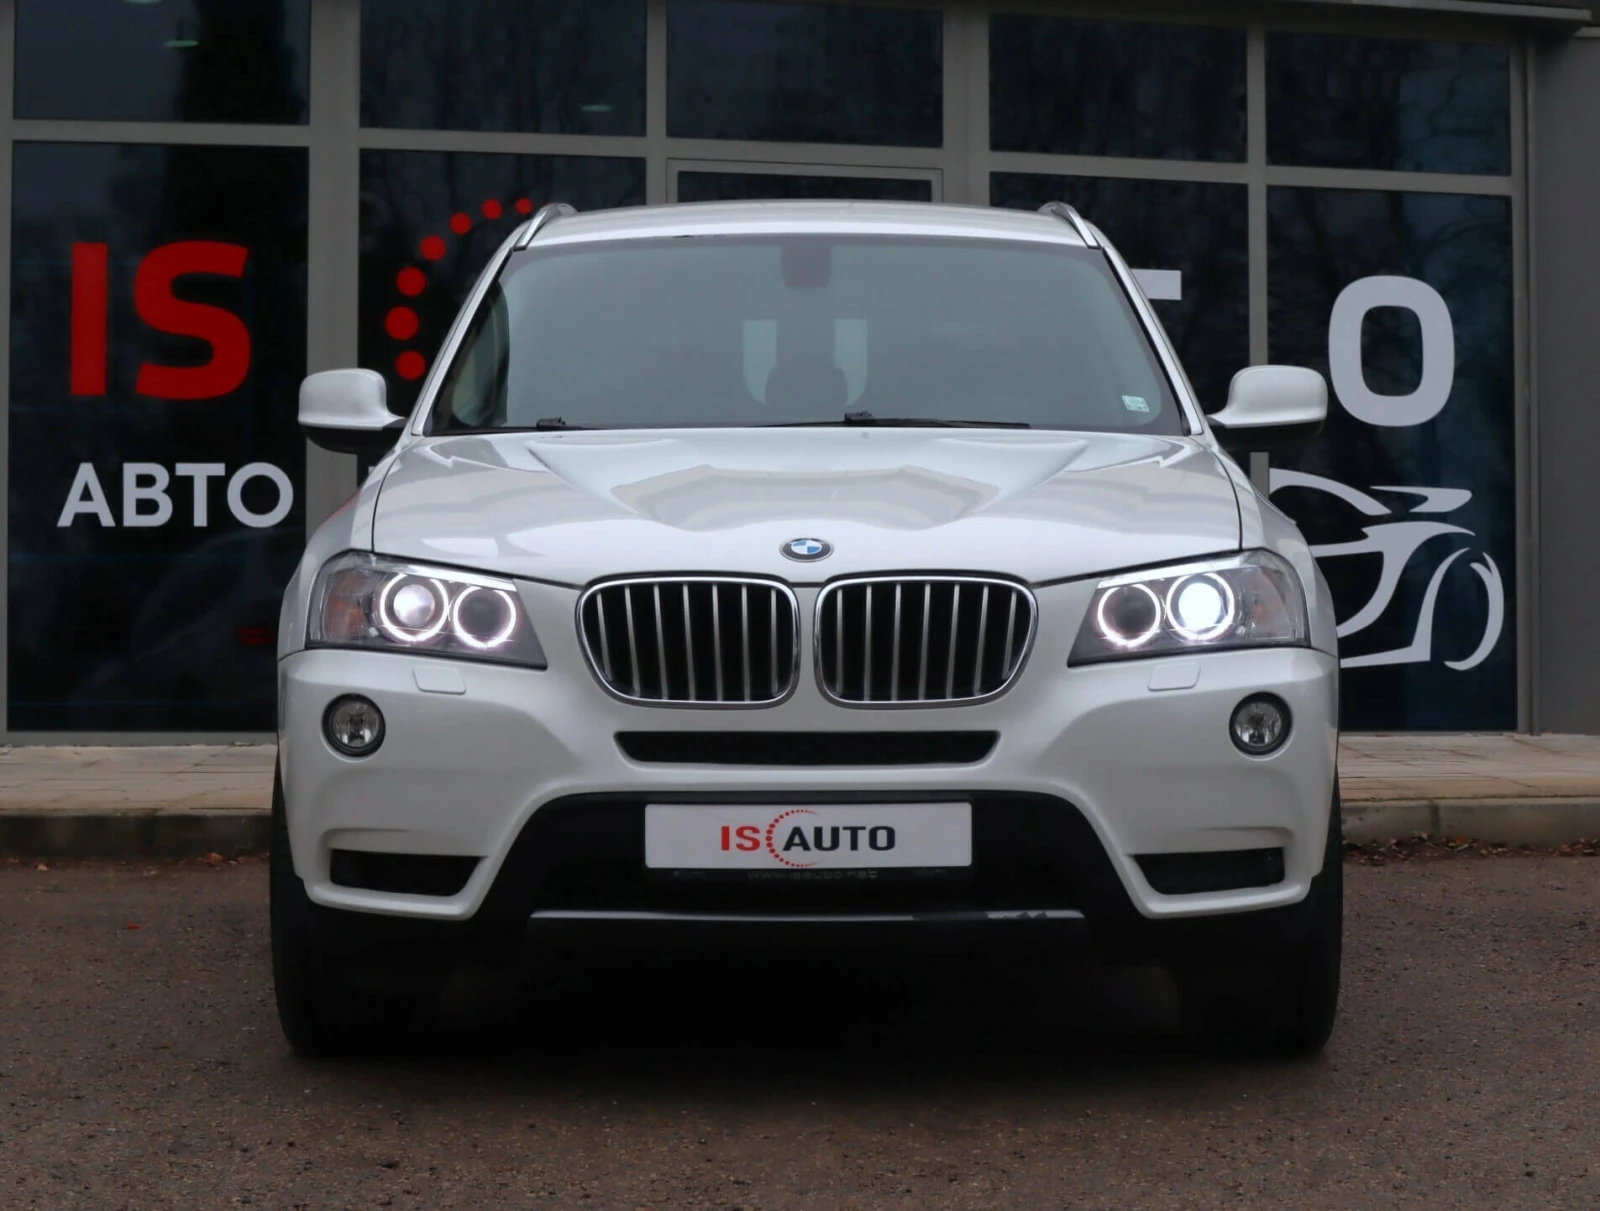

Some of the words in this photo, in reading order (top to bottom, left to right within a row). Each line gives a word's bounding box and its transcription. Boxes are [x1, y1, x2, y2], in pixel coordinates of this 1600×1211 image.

[71, 240, 252, 400] IS
[57, 462, 294, 528] АВТО
[720, 825, 761, 852] IS
[782, 825, 896, 852] AUTO
